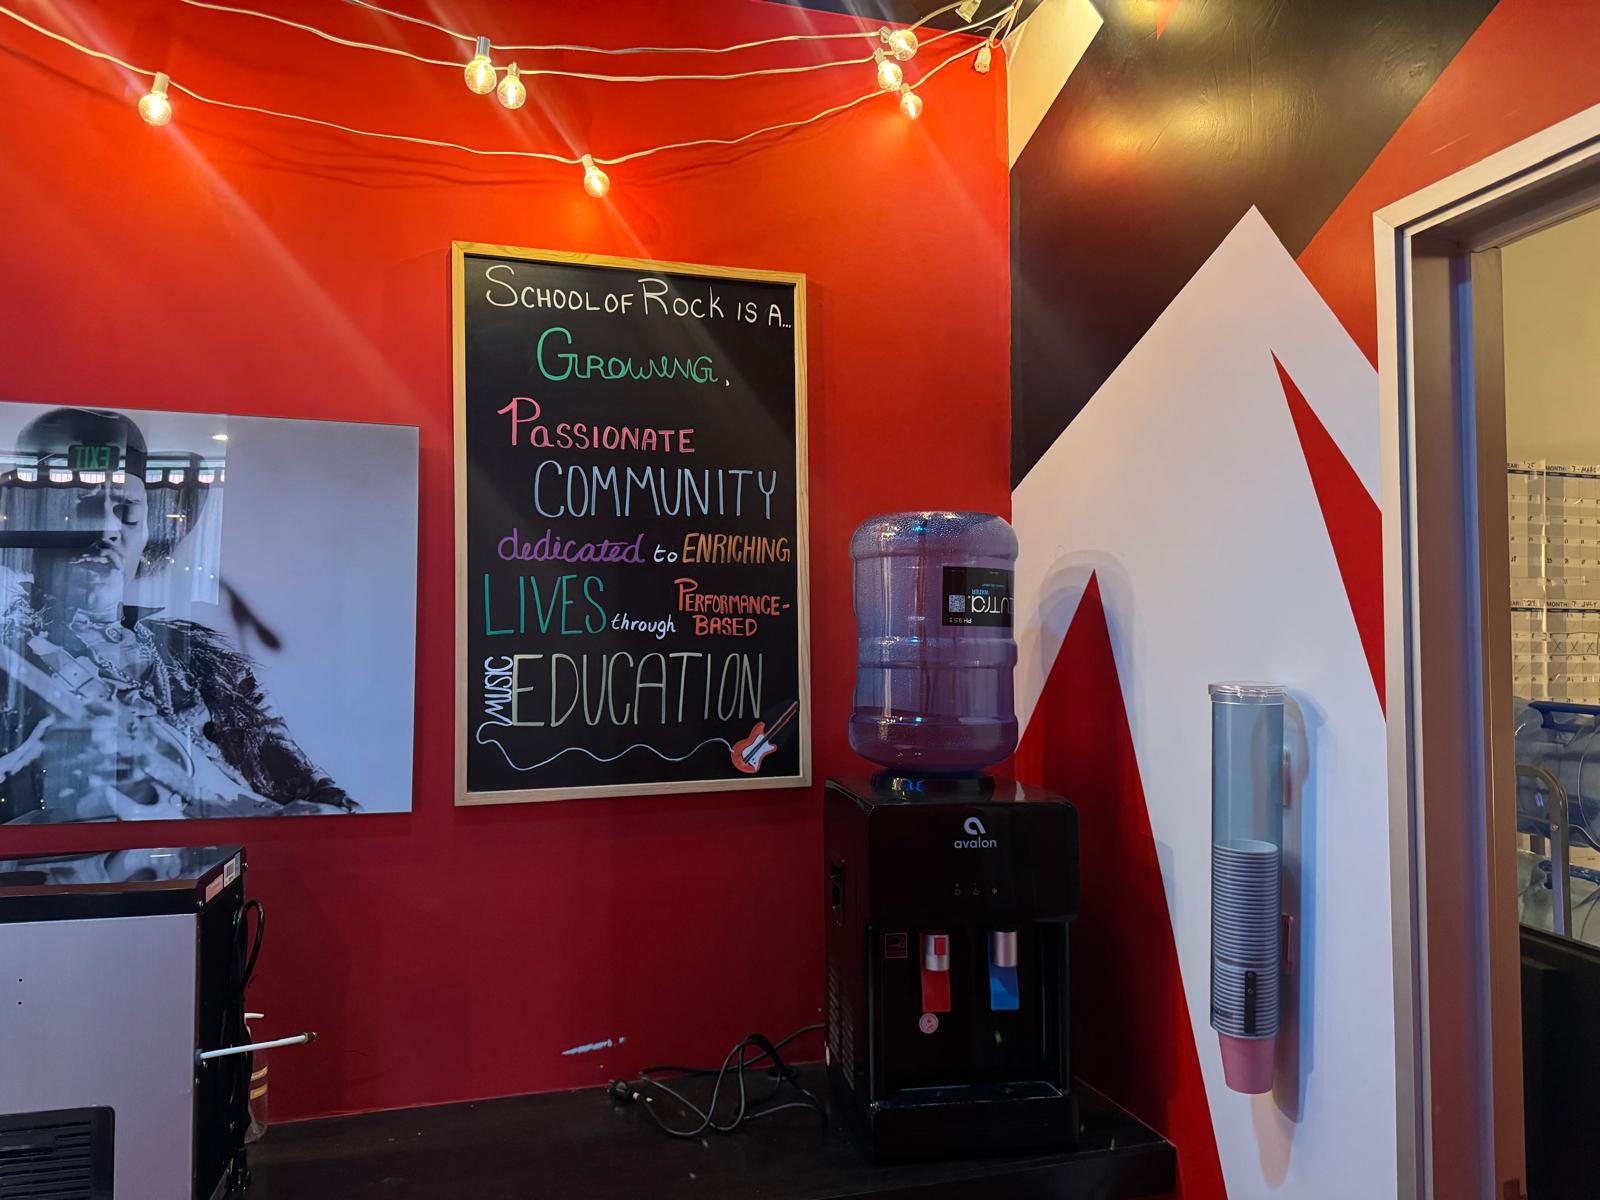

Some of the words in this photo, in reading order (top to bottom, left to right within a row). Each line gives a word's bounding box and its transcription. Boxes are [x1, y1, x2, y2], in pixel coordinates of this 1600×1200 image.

[485, 265, 600, 311] SCHOOL
[604, 293, 635, 314] OF
[638, 278, 725, 319] ROCK
[737, 302, 758, 323] IS
[534, 460, 777, 520] COMMUNITY
[497, 528, 645, 563] dedicated
[653, 544, 678, 563] to
[682, 532, 791, 564] ENRICHING
[484, 574, 607, 635] LIVES
[611, 613, 677, 640] through
[692, 615, 758, 637] BASED
[484, 656, 513, 727] MUSIC
[512, 652, 763, 728] EDUCATION
[954, 836, 997, 849] avalon
